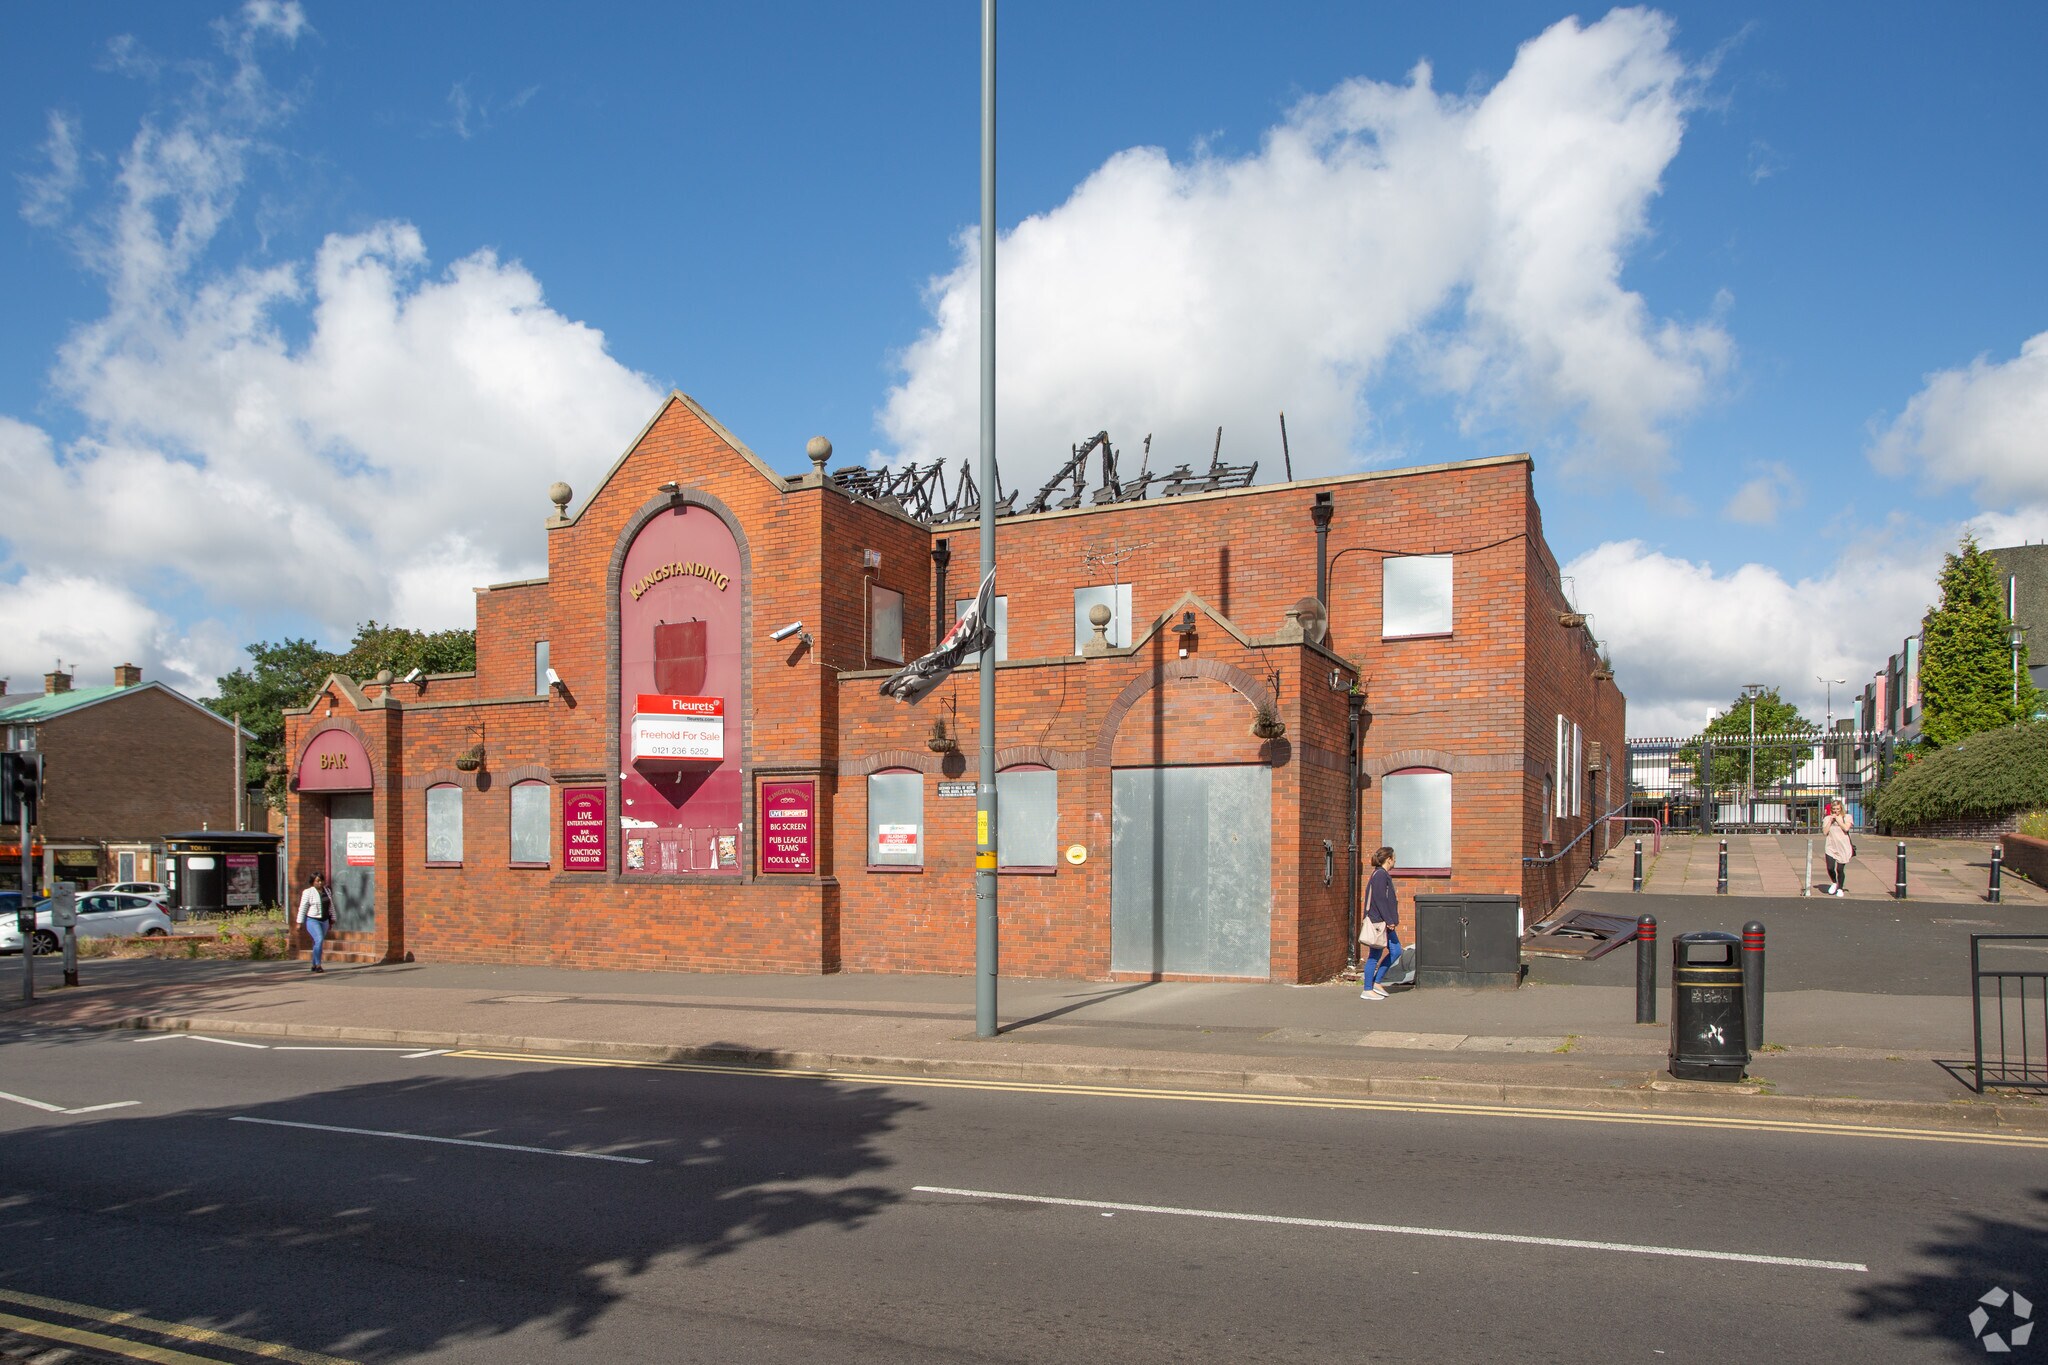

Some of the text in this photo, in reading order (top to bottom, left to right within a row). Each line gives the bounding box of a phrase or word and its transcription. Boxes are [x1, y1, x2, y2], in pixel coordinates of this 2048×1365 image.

[630, 562, 730, 602] KINGSTANDING
[672, 699, 714, 711] Fleurets
[640, 729, 720, 741] Freehold For Sale
[652, 746, 709, 755] 0121 236 5252
[320, 752, 348, 769] BAR
[767, 788, 810, 803] KINGSTANDING
[577, 811, 592, 820] LIVE
[571, 835, 599, 843] SNACKS
[569, 848, 601, 856] FUNCTIONS
[777, 844, 799, 852] TEAMS
